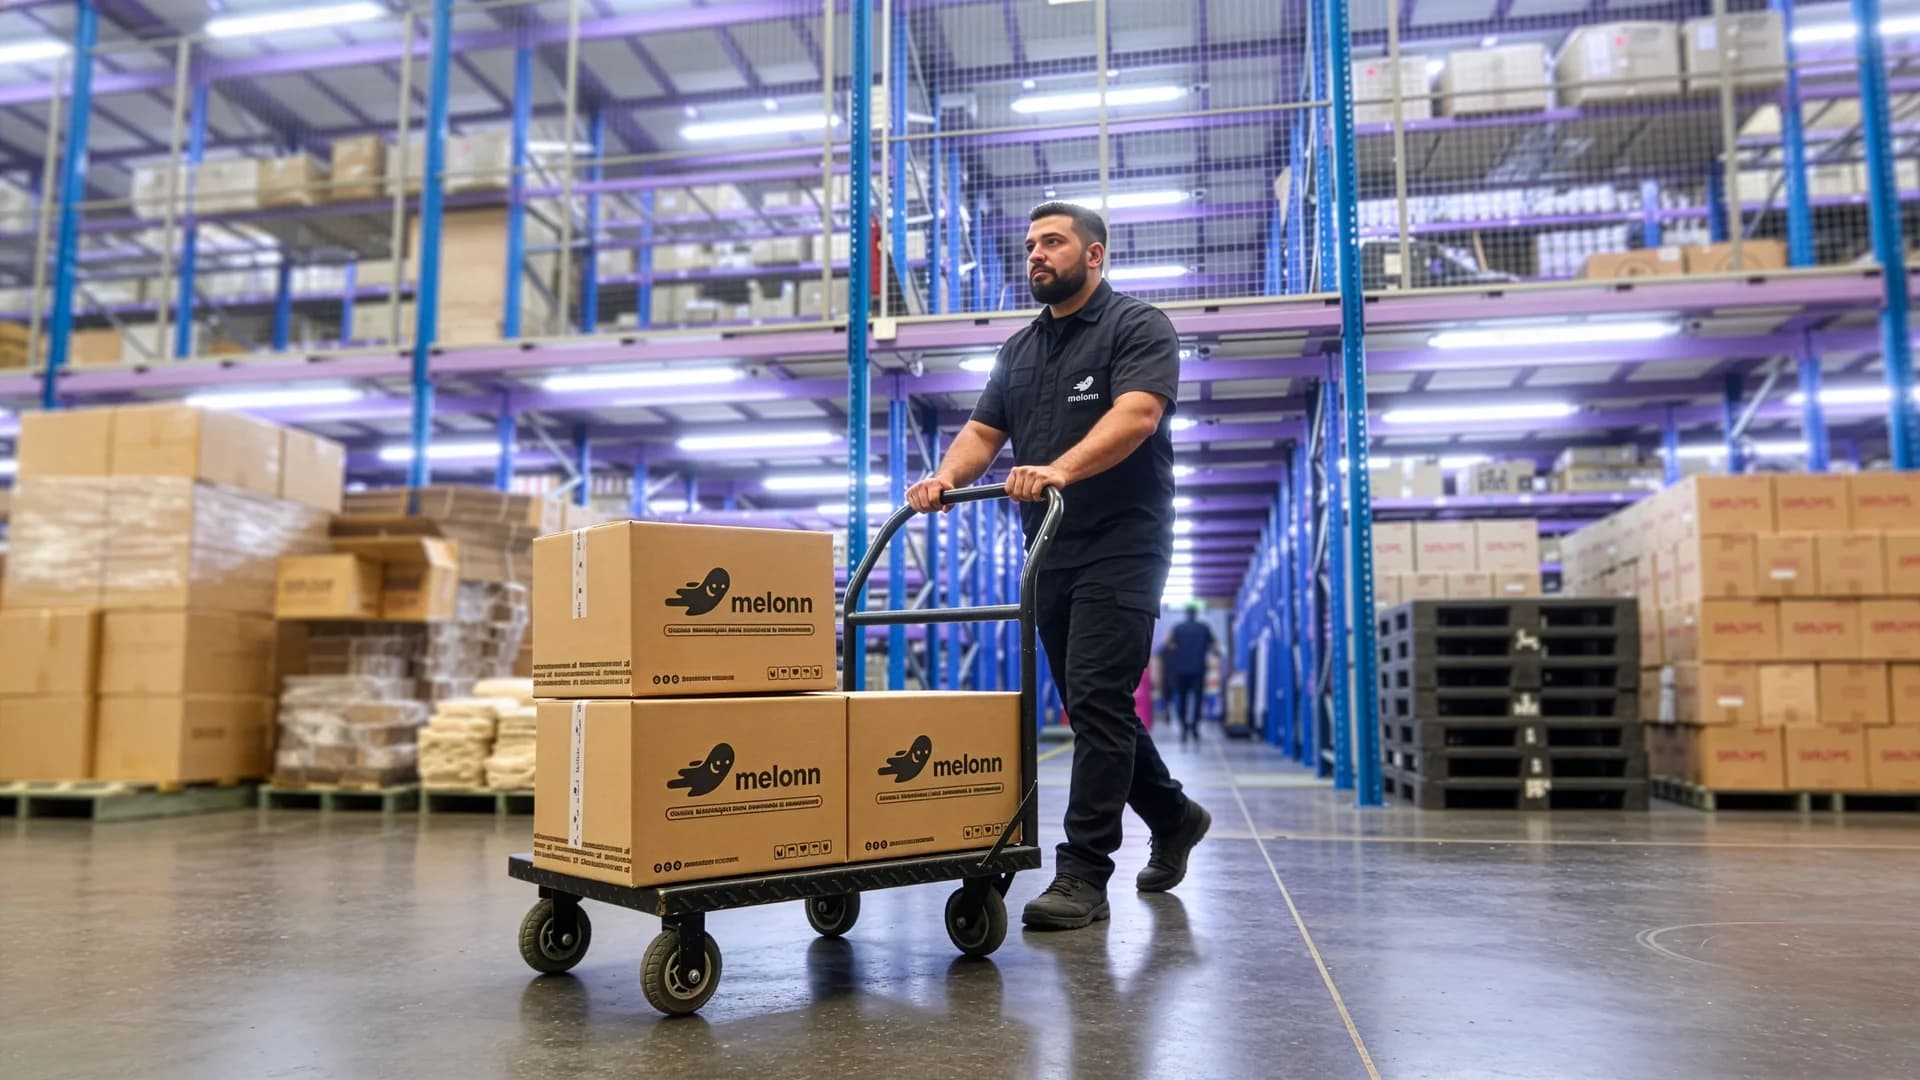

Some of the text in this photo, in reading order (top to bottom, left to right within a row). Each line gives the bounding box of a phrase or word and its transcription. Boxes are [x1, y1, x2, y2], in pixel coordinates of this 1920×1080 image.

[1067, 393, 1099, 402] melonn
[732, 591, 812, 613] melonn
[933, 754, 1002, 776] melonn
[735, 765, 821, 791] melonn
